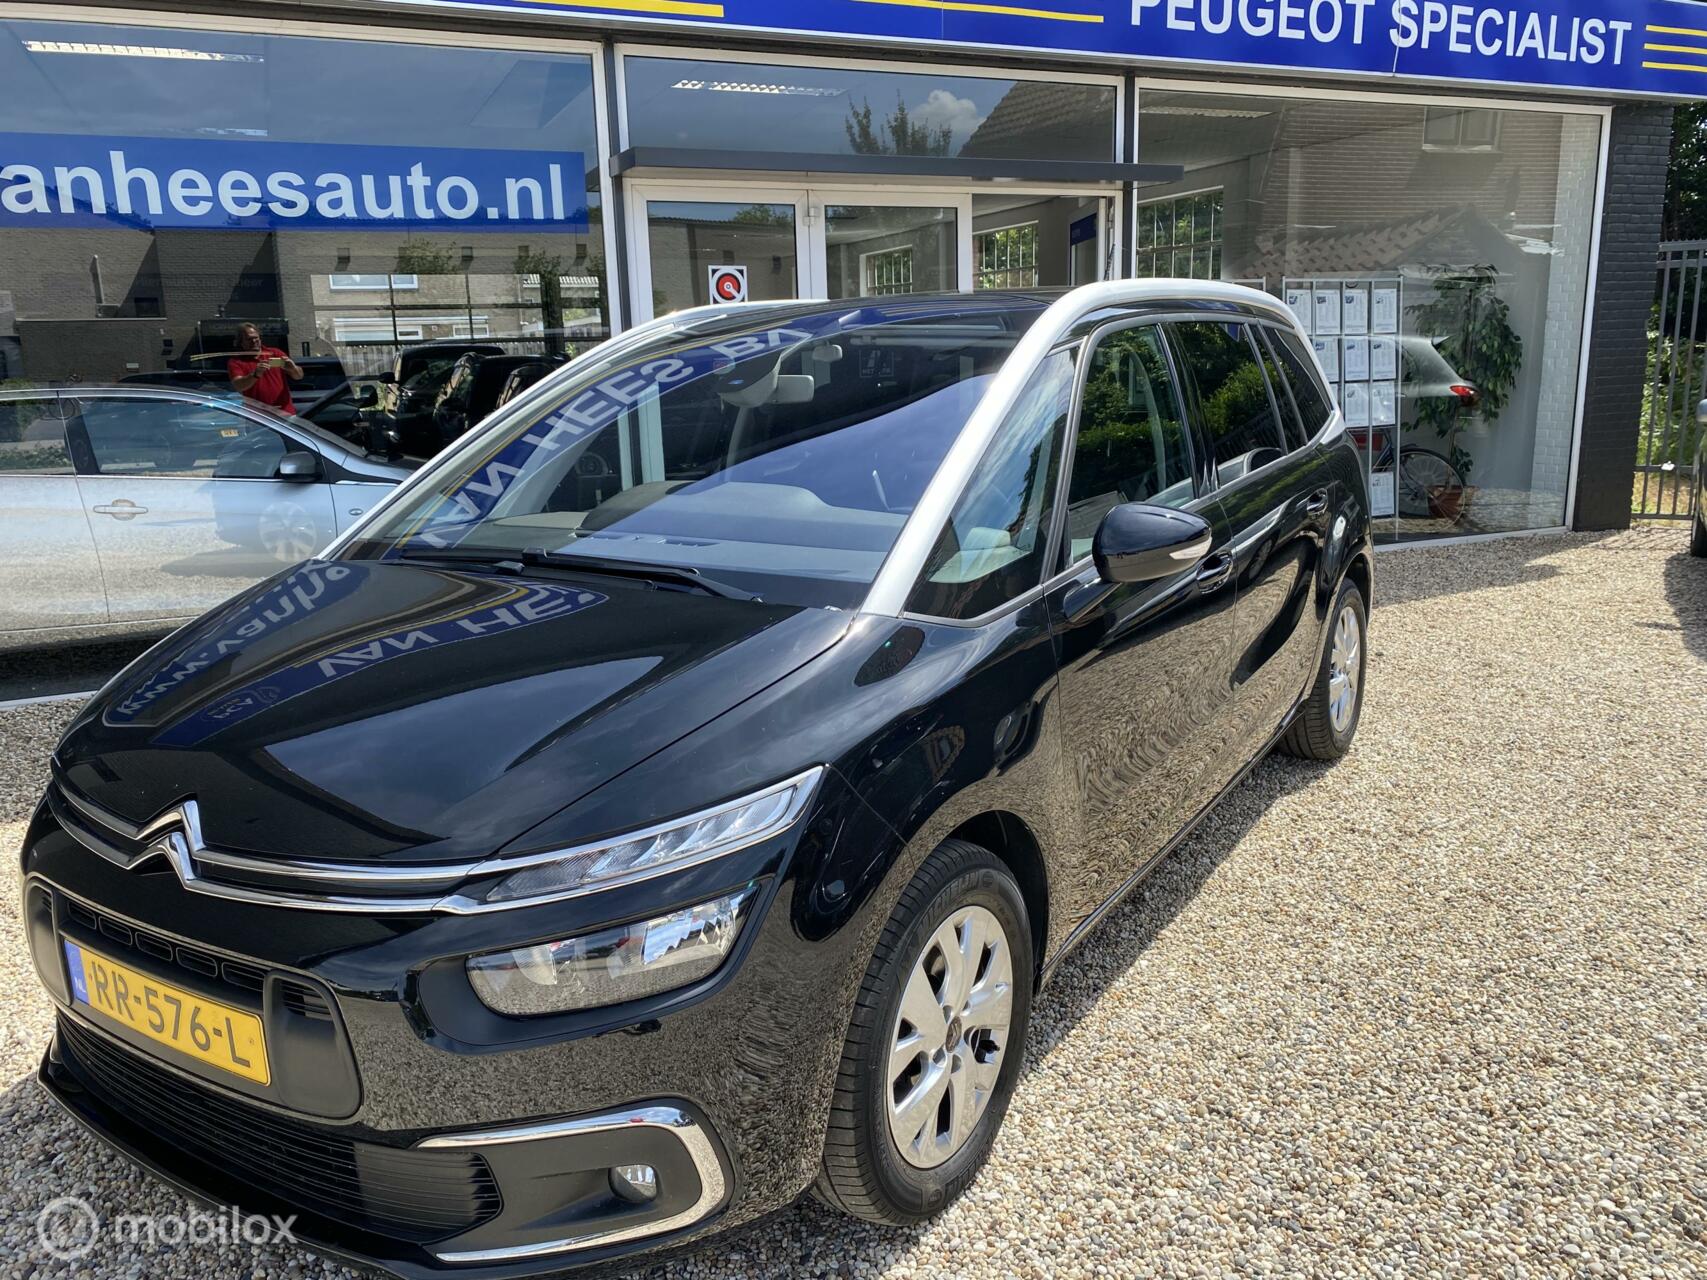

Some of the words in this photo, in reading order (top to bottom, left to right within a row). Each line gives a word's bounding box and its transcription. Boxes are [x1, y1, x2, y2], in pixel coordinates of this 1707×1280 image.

[1131, 0, 1375, 45] PEUGEOT
[1389, 0, 1632, 65] SPECIALIST
[0, 150, 565, 220] anheesauto.nl
[91, 960, 251, 1069] RR-576-L
